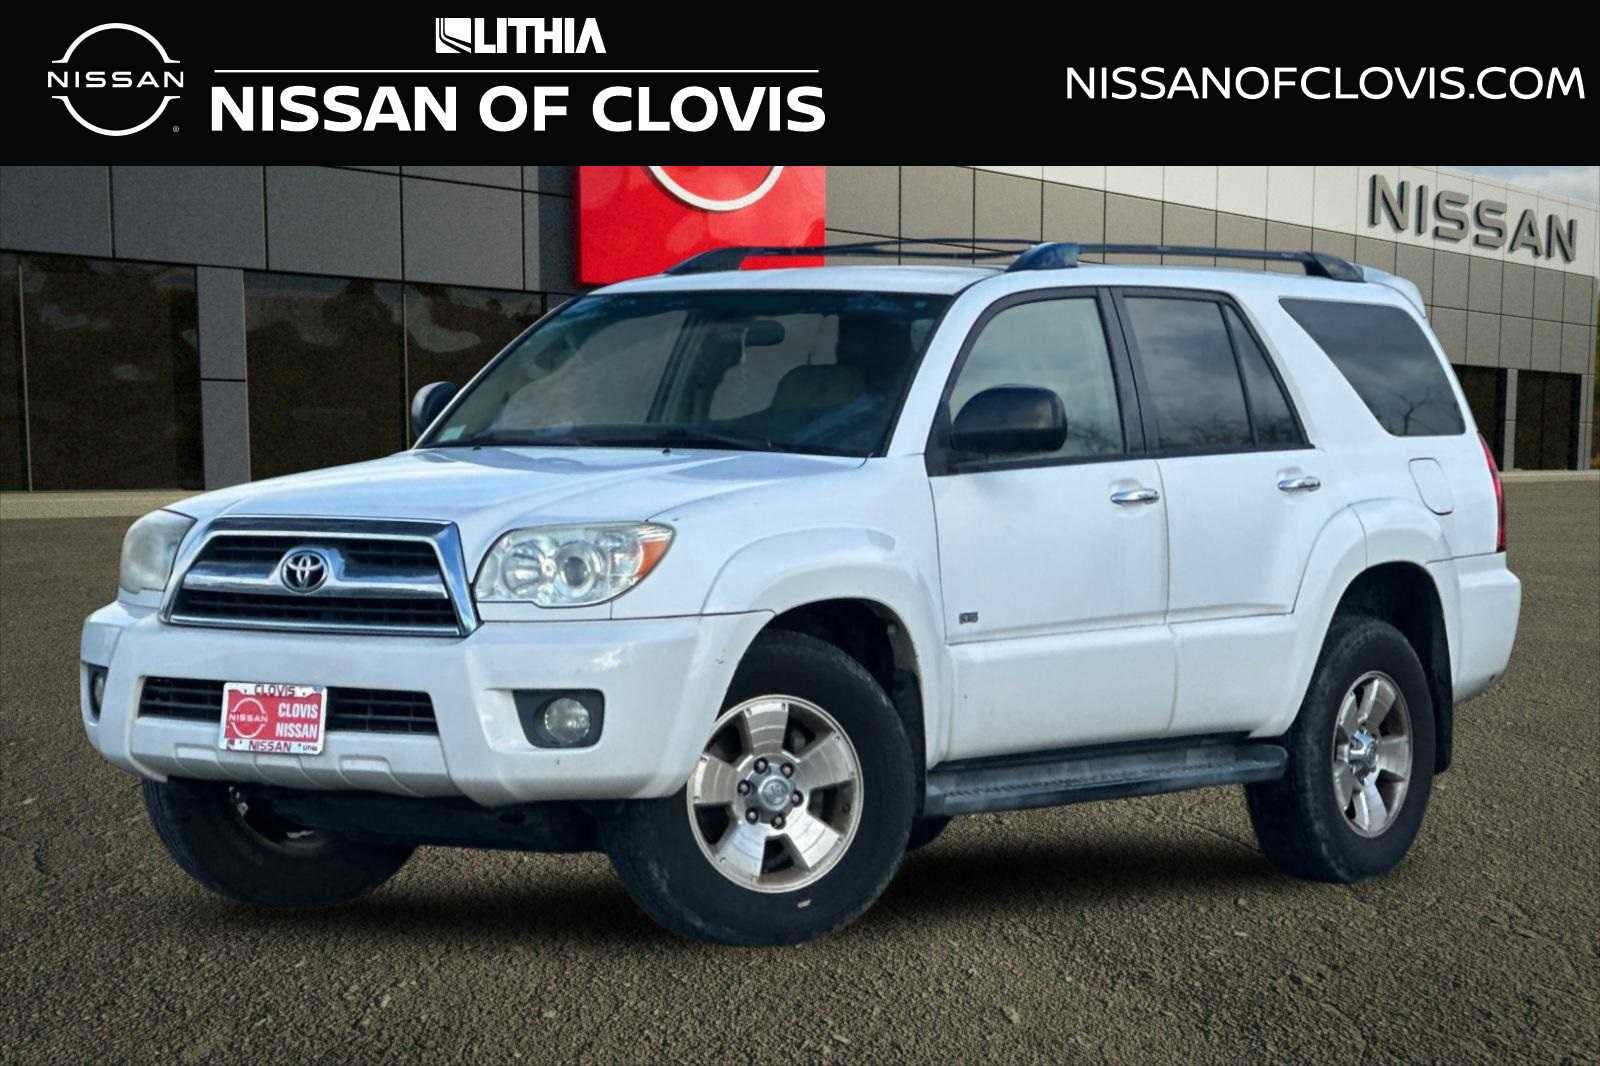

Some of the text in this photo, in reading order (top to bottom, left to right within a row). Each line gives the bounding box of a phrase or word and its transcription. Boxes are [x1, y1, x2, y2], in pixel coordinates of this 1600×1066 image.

[1368, 174, 1578, 263] NISSAN
[254, 685, 295, 697] CLOVIS
[228, 713, 269, 722] NISSAN
[278, 702, 319, 719] CLOVIS
[275, 722, 318, 739] NISSAN
[248, 740, 292, 752] NISSAN
